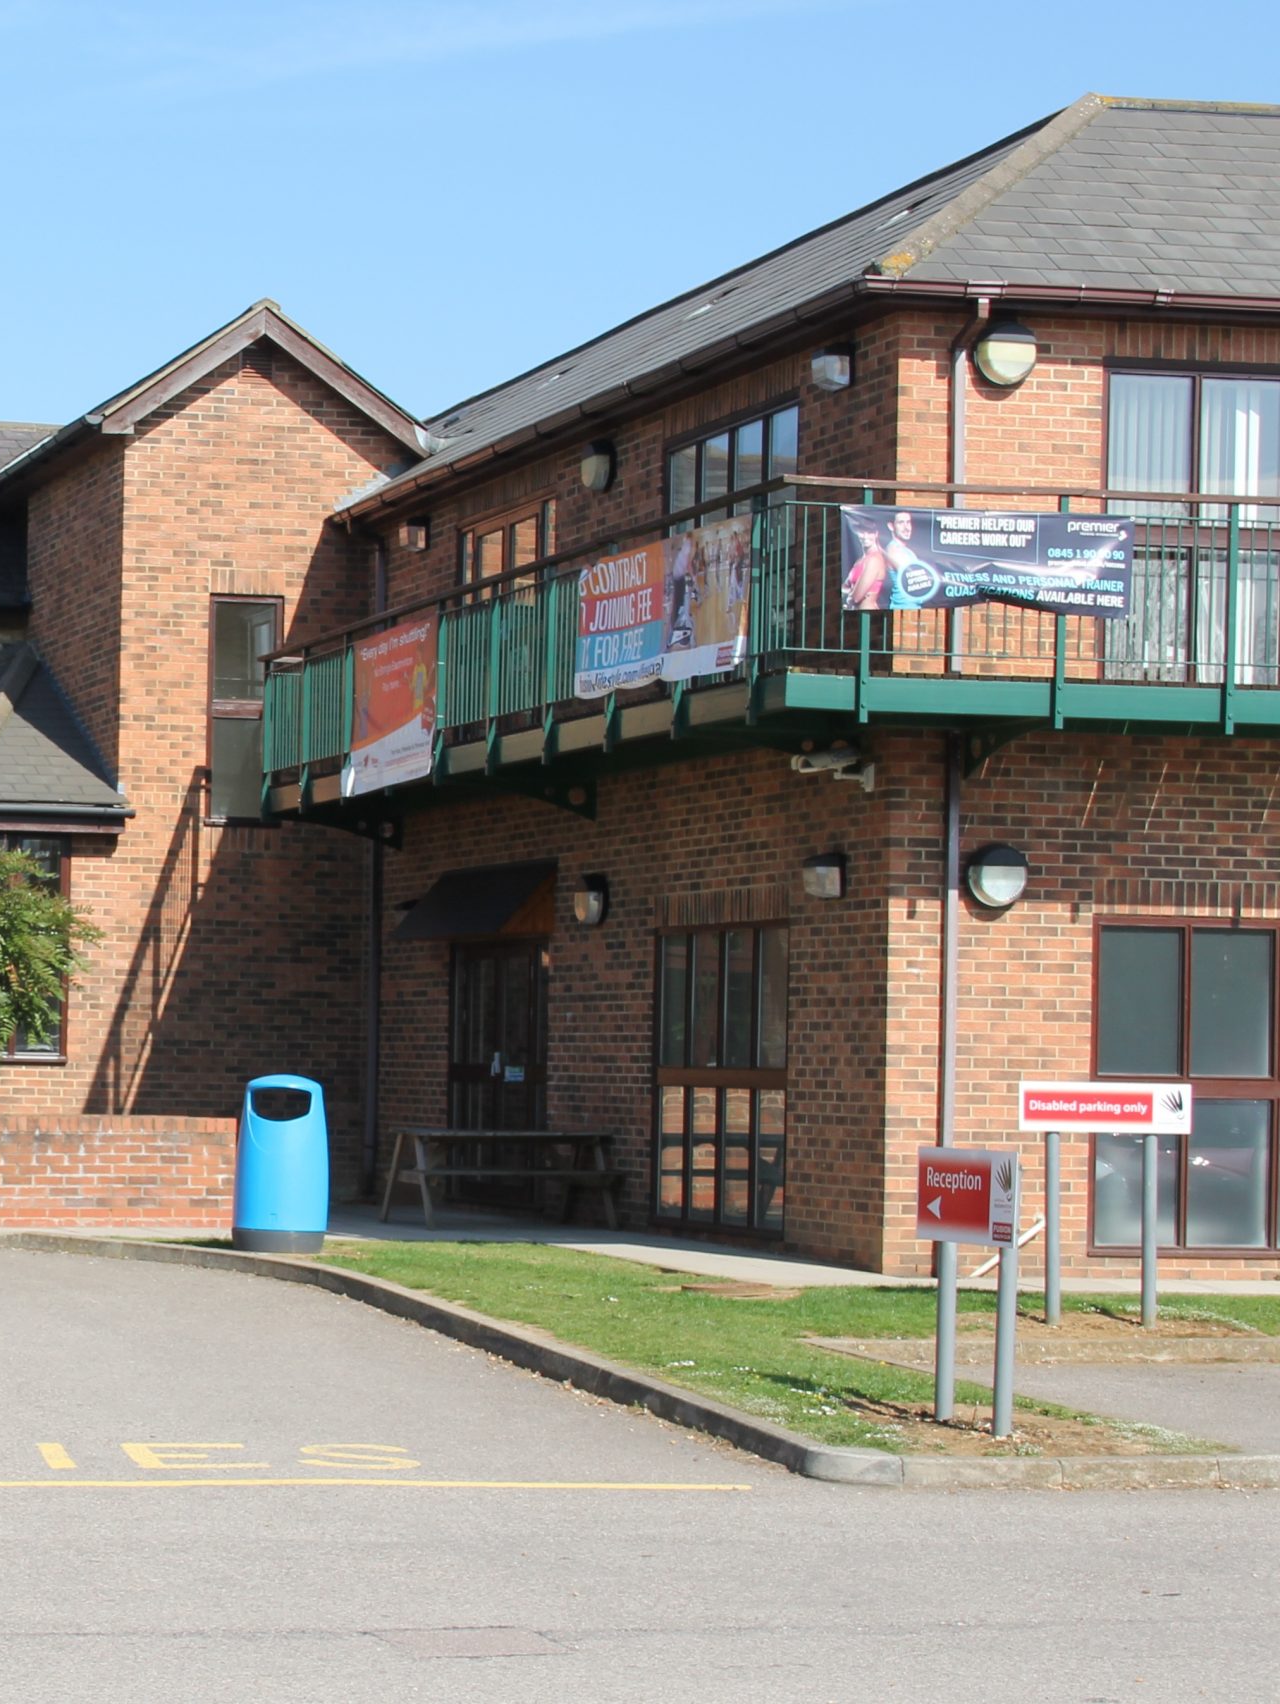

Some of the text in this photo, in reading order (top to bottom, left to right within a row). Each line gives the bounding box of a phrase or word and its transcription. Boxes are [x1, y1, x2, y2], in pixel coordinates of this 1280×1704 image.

[936, 515, 1035, 533] "PREMIER HELPED OUR
[1067, 520, 1120, 533] premier
[940, 531, 1032, 548] CAREERS WORK OUT"
[1047, 547, 1074, 558] 0845
[1076, 549, 1081, 558] 1
[1083, 549, 1097, 559] 90
[1112, 550, 1125, 560] 90
[588, 552, 647, 595] CONTRACT
[944, 571, 1125, 593] FITNESS AND PERSONAL TRAINER
[1036, 590, 1095, 606] AVAILABLE
[1096, 595, 1125, 608] HERE
[589, 593, 636, 632] JOINING
[637, 587, 653, 623] FEE
[594, 634, 620, 668] FOR
[619, 627, 645, 662] FREE
[1028, 1098, 1148, 1115] Disabled parking only
[926, 1165, 982, 1194] Reception
